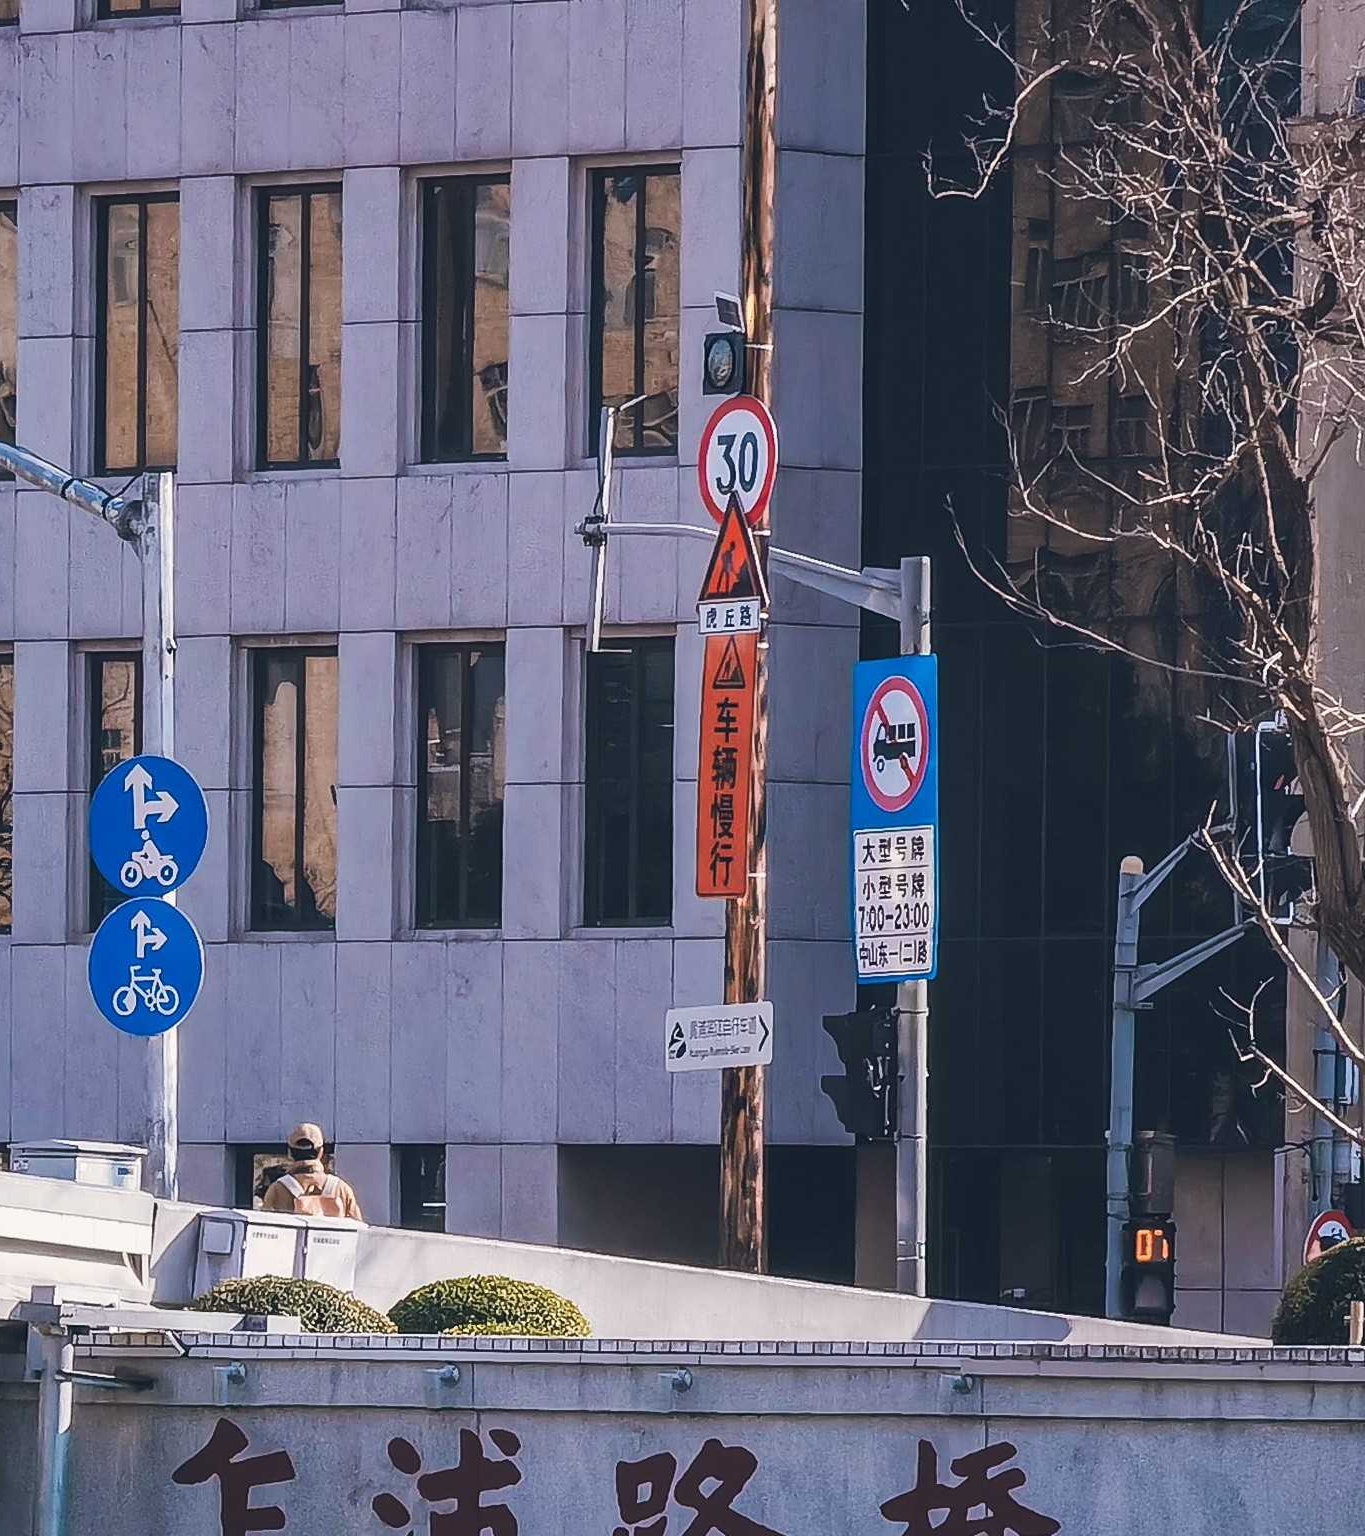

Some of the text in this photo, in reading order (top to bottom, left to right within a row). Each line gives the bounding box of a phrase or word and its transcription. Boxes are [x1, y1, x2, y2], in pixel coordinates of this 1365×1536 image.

[715, 431, 758, 494] 30
[706, 605, 751, 628] 虎丘路
[710, 697, 739, 887] 车辆慢行
[862, 835, 925, 864] 大型号牌
[862, 872, 925, 901] 小型号牌
[858, 902, 929, 933] 7:00-23:00
